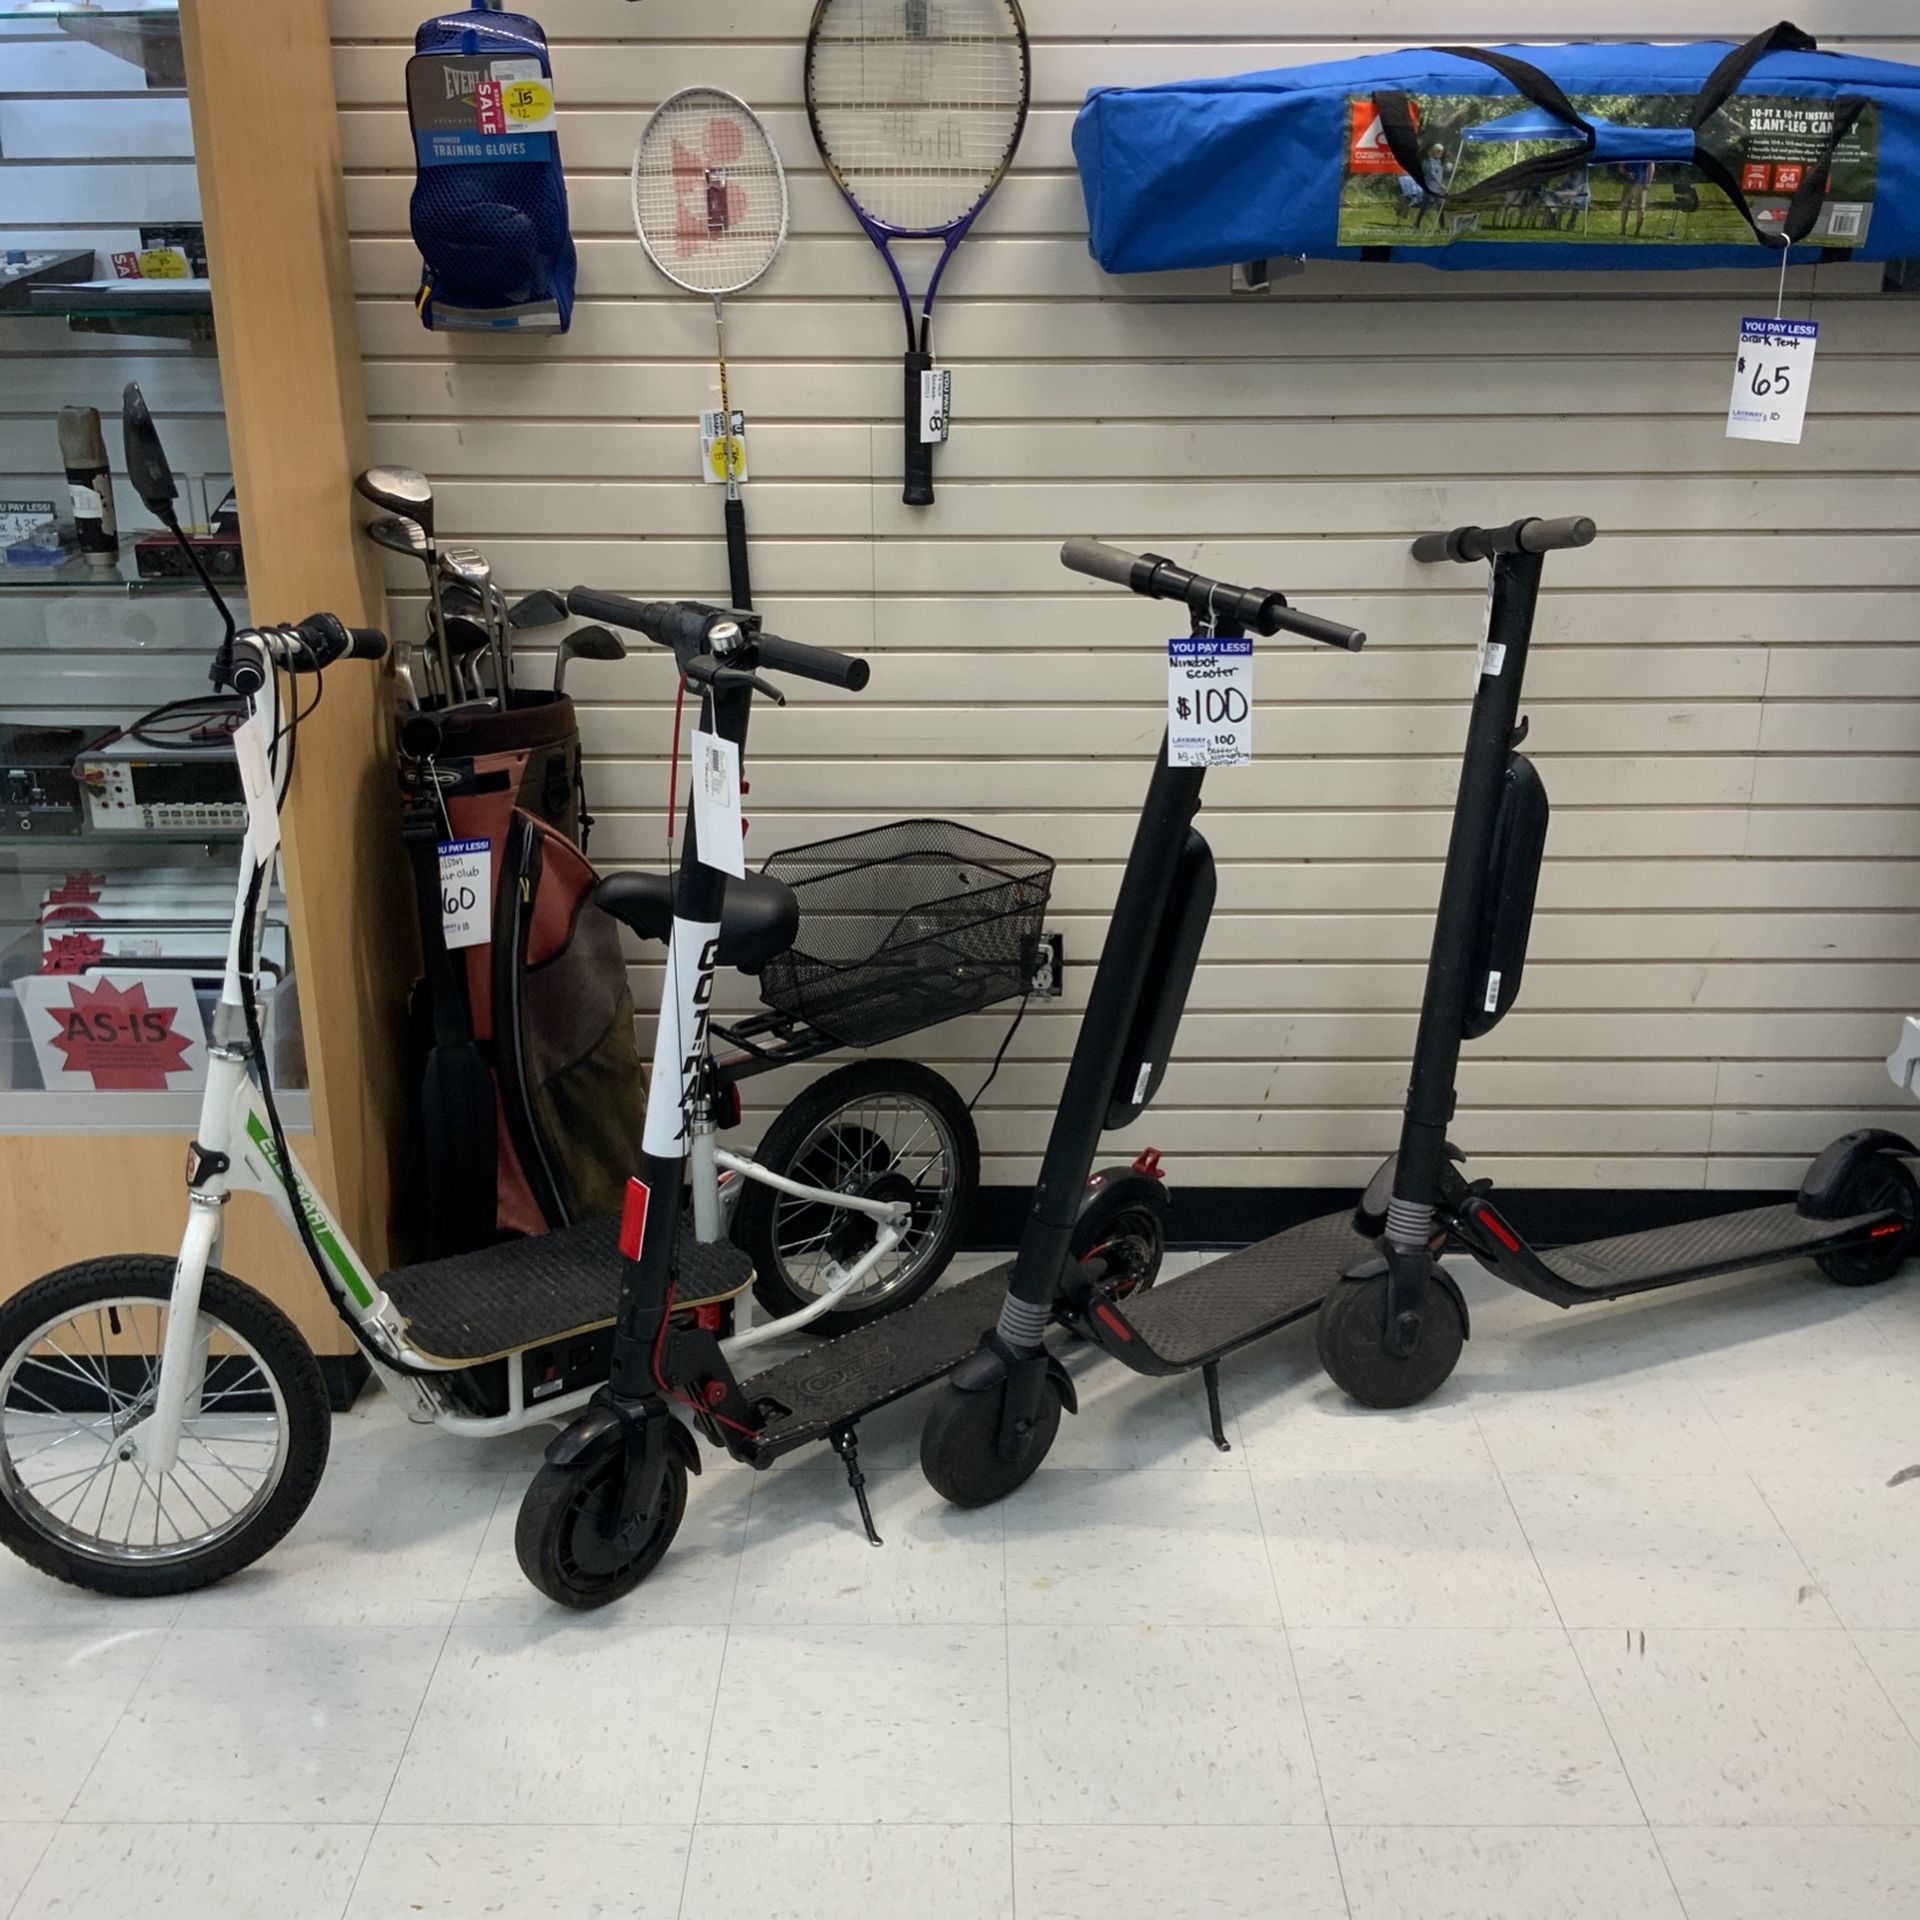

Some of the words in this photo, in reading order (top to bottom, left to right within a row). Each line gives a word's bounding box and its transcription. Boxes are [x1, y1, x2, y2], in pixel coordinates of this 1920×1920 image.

[518, 90, 533, 106] 15
[479, 84, 496, 135] SALE
[1751, 108, 1773, 118] 10-FT
[1783, 110, 1803, 120] 10-FT
[1805, 111, 1835, 121] INSTAN
[1750, 118, 1808, 134] SLANT-LEG
[1811, 121, 1860, 136] CANY
[433, 144, 482, 157] TRAINING
[486, 143, 526, 156] GLOVES
[1779, 173, 1796, 183] 64
[1745, 321, 1766, 332] YOU
[1767, 323, 1787, 333] PAY
[1788, 325, 1815, 336] LESS!
[8, 503, 25, 512] PAY
[1172, 643, 1195, 653] YOU
[1198, 643, 1218, 653] PAY
[1221, 643, 1250, 652] LESS!
[1176, 687, 1248, 724] $100
[1215, 734, 1236, 745] 100
[448, 844, 464, 853] PAY
[466, 841, 489, 851] LESS!
[443, 886, 476, 914] 60
[66, 1012, 168, 1043] AS-IS
